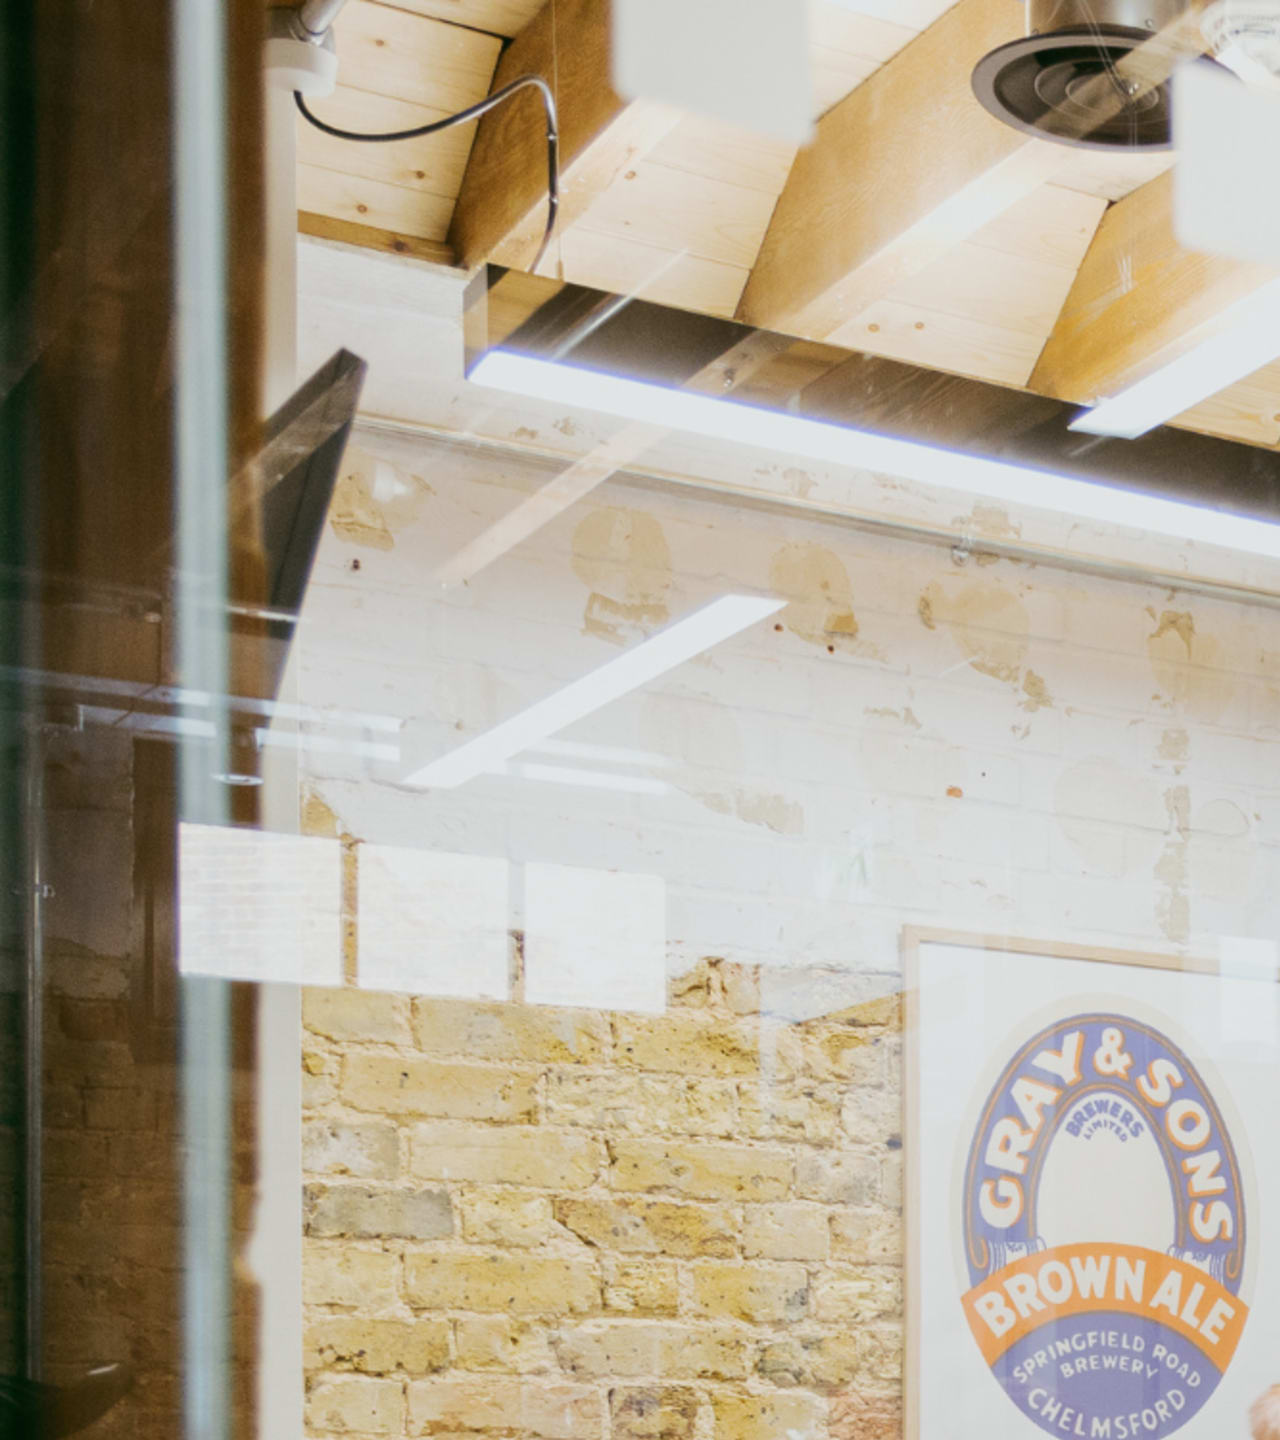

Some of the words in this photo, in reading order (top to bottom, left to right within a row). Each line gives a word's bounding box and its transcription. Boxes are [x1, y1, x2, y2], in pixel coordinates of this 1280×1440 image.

[979, 1030, 1083, 1228] GRAY
[1093, 1027, 1134, 1080] &
[1137, 1057, 1234, 1245] SONS
[1065, 1099, 1144, 1138] BREWERS
[1083, 1119, 1128, 1142] LIMITED
[973, 1255, 1147, 1339] BROWN
[1150, 1273, 1237, 1346] ALE
[1012, 1330, 1146, 1385] SPRINGFIELD
[1152, 1343, 1202, 1388] ROAD
[1060, 1354, 1159, 1380] BREWERY
[1027, 1386, 1186, 1440] CHELMSFORD
